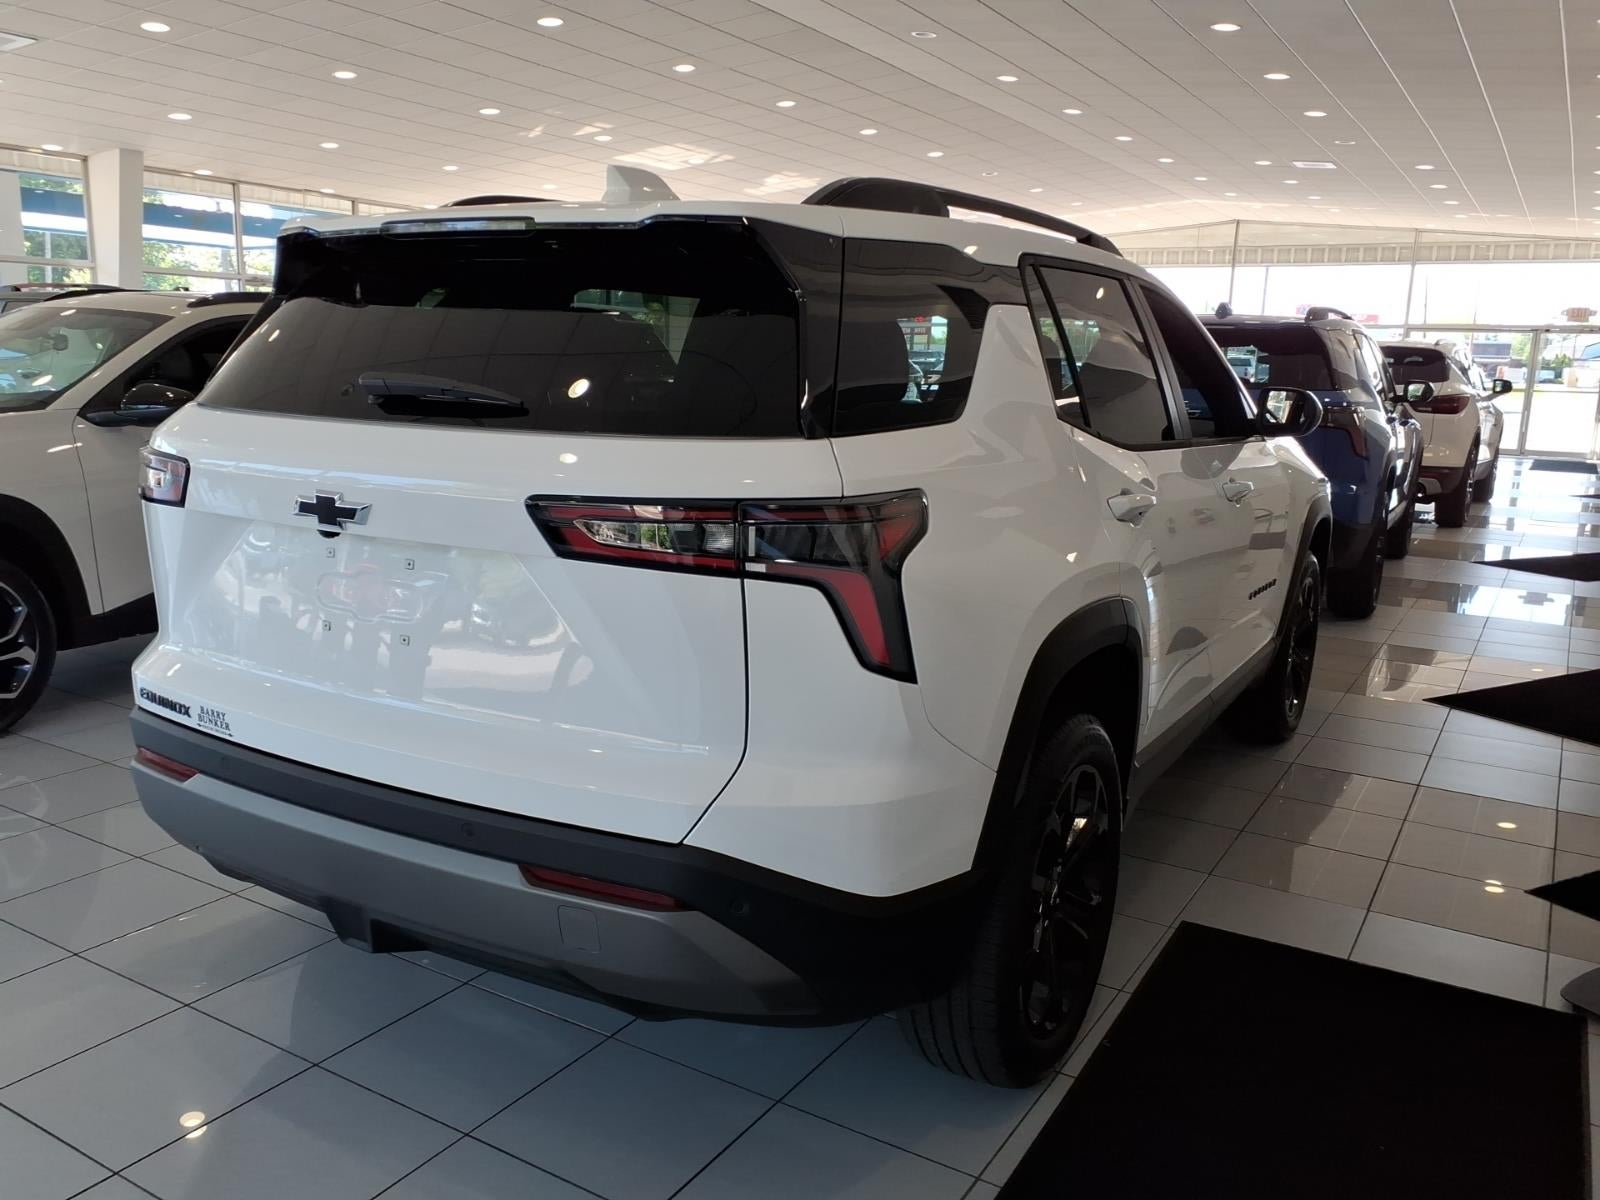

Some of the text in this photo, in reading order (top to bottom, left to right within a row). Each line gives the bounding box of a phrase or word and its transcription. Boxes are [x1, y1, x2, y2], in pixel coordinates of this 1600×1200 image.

[140, 687, 191, 717] EQUINOX
[198, 713, 230, 731] BUNKER
[200, 705, 226, 721] BARRY
